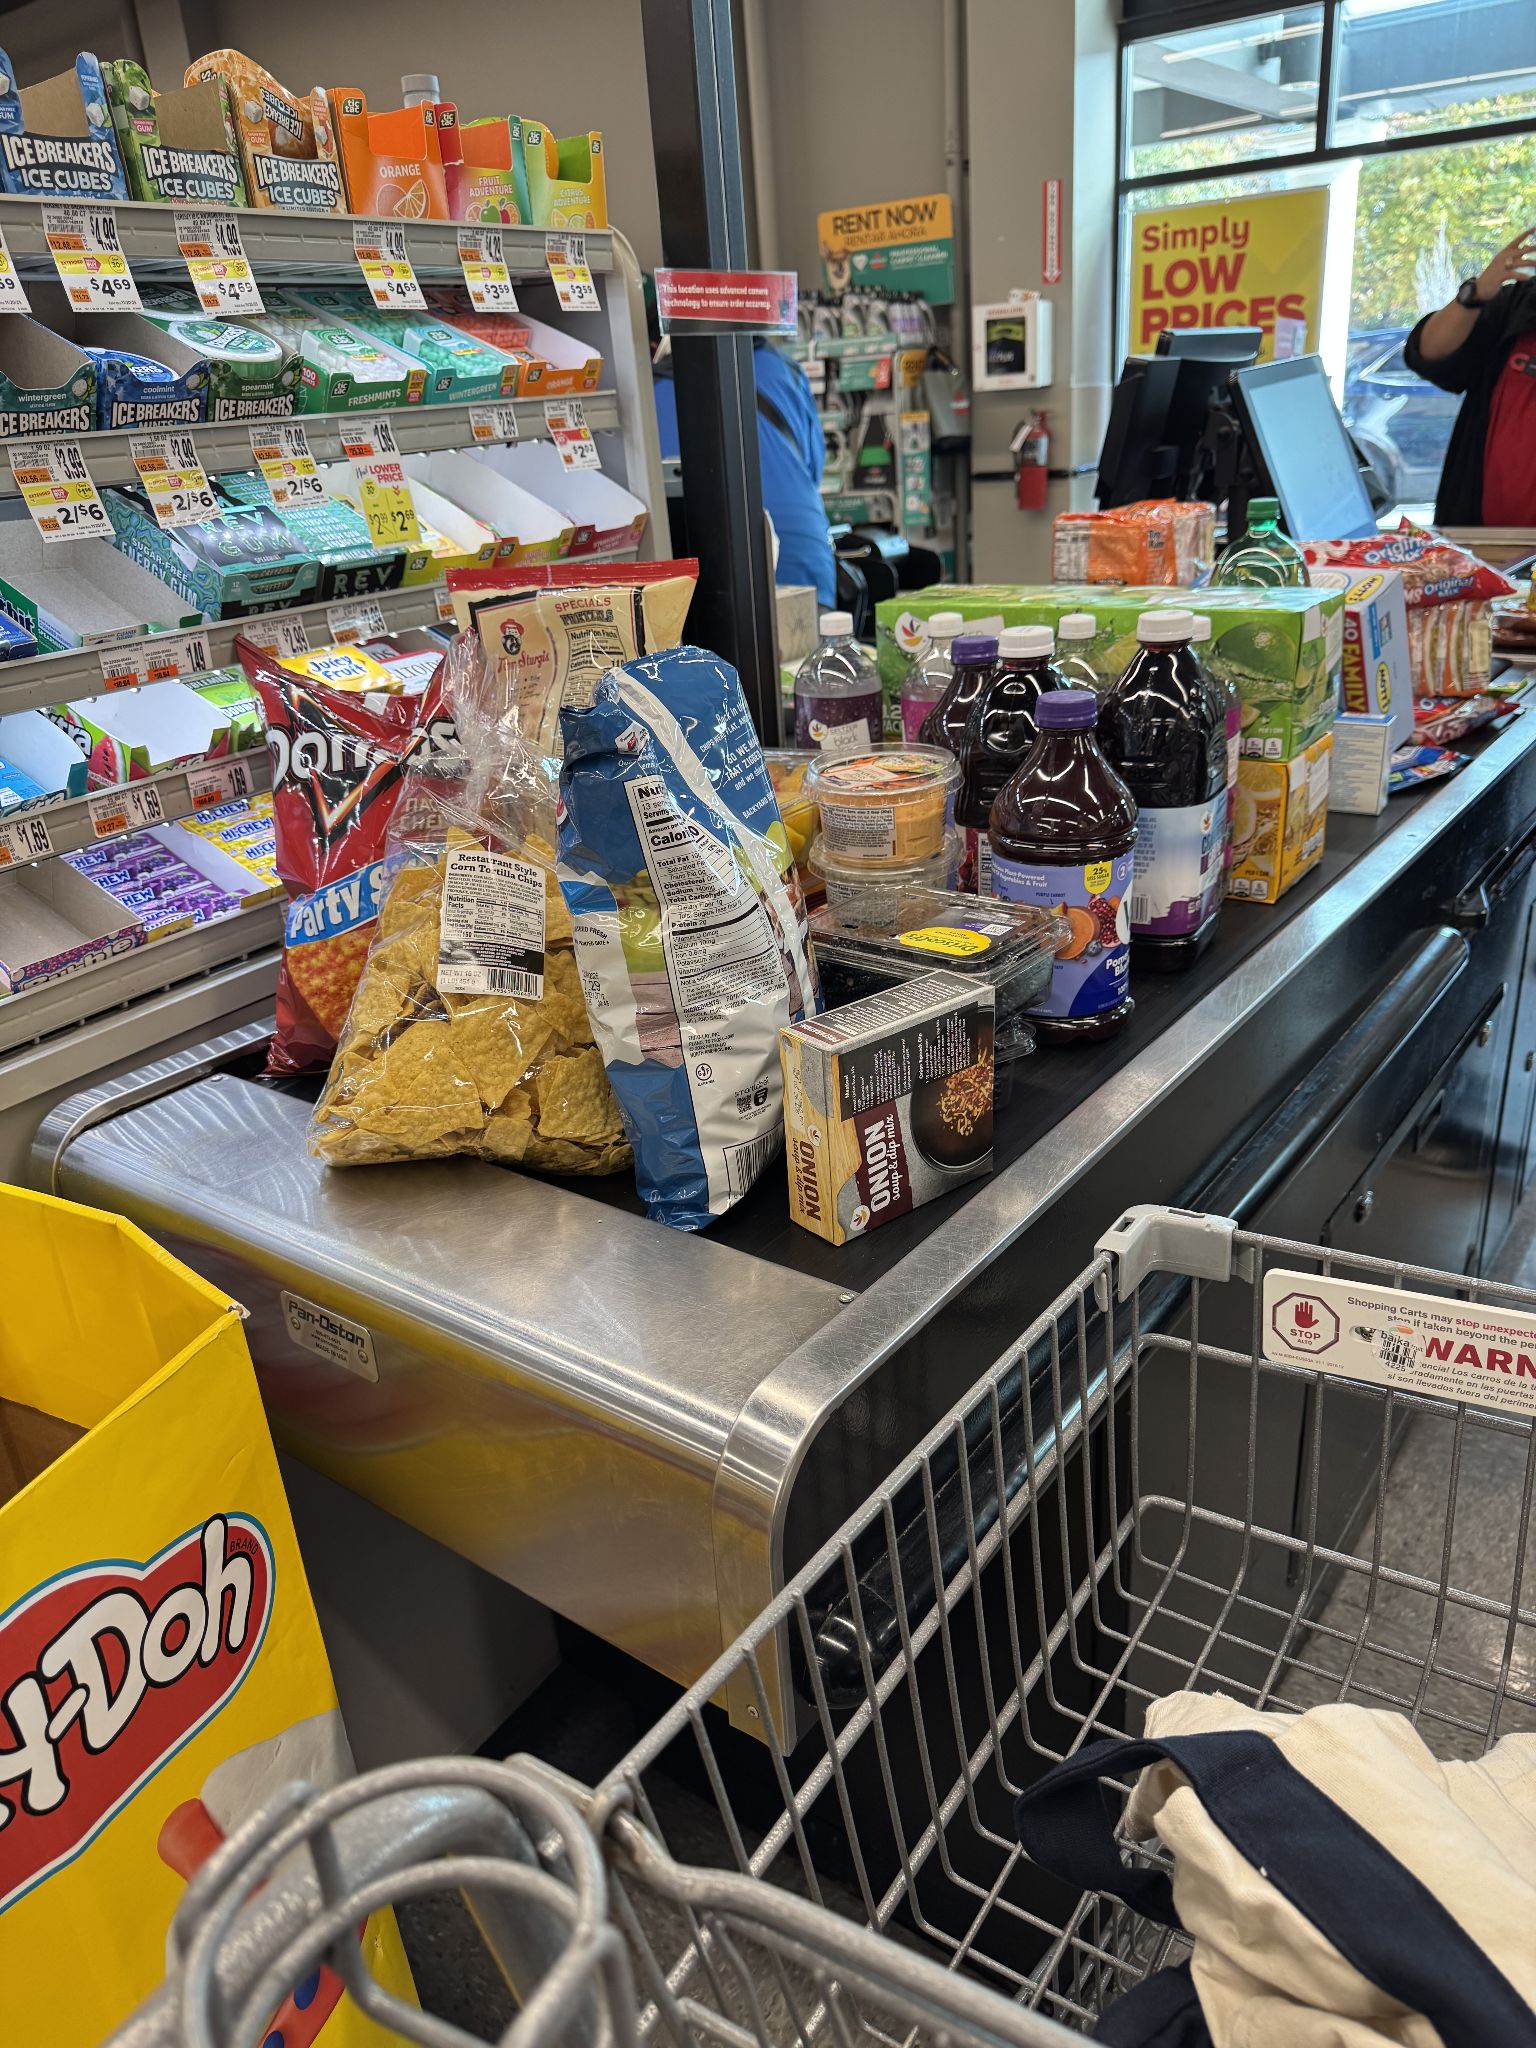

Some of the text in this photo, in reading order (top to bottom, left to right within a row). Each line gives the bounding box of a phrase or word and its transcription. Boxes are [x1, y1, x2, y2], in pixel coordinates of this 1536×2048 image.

[2, 134, 117, 174] ICE BREAKERS
[142, 145, 238, 183] ICE BREAKERS
[380, 164, 421, 179] ORANGE
[21, 169, 112, 191] ICE CUBES
[255, 157, 340, 194] ICE BREAKERS
[479, 176, 500, 187] FRUIT
[158, 179, 234, 199] ICE CUBES
[269, 185, 336, 207] ICE CUBES
[469, 185, 512, 197] ADVENTURE
[560, 189, 582, 198] CITRUS
[554, 196, 590, 206] ADVENTURE
[833, 201, 937, 236] RENT NOW
[1141, 216, 1249, 252] Simply
[1142, 253, 1247, 300] LOW
[662, 285, 768, 296] This location uses advanced camera
[664, 299, 700, 310] technology
[709, 300, 728, 309] ensure
[729, 300, 744, 309] order
[745, 300, 771, 310] accuracy.
[1140, 293, 1305, 345] PRICES
[302, 367, 316, 380] 100
[18, 392, 67, 402] wintergreen
[143, 385, 174, 394] coolmint
[241, 383, 274, 392] spearmint
[334, 387, 346, 395] tac
[449, 382, 497, 402] WINTERGREEN
[216, 394, 294, 420] ICE BREAKERS
[348, 388, 401, 407] FRESHMINTS
[19, 405, 90, 430] BREAKERS
[112, 399, 200, 427] ICE BREAKERS
[369, 463, 401, 475] LOWER
[377, 472, 404, 483] PRICE
[288, 477, 323, 496] 2/$6
[172, 491, 213, 511] 2/$6
[57, 503, 103, 524] 2/$6
[198, 512, 264, 533] REV
[219, 535, 292, 556] GUM
[132, 537, 188, 583] SUGAR-FREE
[121, 541, 197, 608] ENERGY GUM
[333, 565, 395, 593] REV
[1424, 577, 1474, 596] Original
[555, 597, 611, 613] SPECIALS
[560, 610, 613, 626] PRETZELS
[570, 629, 618, 640] Nutrition Facts
[309, 655, 353, 673] Juicy
[519, 650, 549, 668] Sturgis
[1343, 619, 1366, 712] 40 FAMILY
[322, 665, 368, 681] Fruit
[736, 743, 749, 757] WE
[734, 777, 745, 791] and
[131, 789, 161, 821] $1.69
[196, 801, 249, 823] HI-CHEW
[644, 809, 670, 819] Serving
[742, 796, 768, 819] BACKYARD
[17, 820, 49, 853] $1.69
[97, 822, 115, 833] $11.27
[221, 818, 273, 841] HI-CHEW
[458, 854, 537, 877] Restaurant Style
[657, 856, 689, 868] Total Fat
[1093, 867, 1107, 876] 25%
[451, 863, 542, 887] Corn Chips
[1005, 866, 1045, 881] Plant-Powered
[664, 878, 705, 890] Cholesterol
[666, 888, 693, 896] Sodium
[290, 880, 360, 938] Party
[448, 895, 475, 904] Nutrition
[668, 896, 687, 904] Total
[589, 926, 608, 939] FRESH
[671, 920, 698, 928] Protein
[865, 1120, 891, 1213] ONION
[885, 1113, 903, 1201] soup & dip mix
[796, 1174, 804, 1194] dip
[800, 1140, 822, 1222] ONION
[797, 1194, 805, 1214] mix
[1348, 1297, 1397, 1314] Shopping
[1400, 1306, 1428, 1319] Carts
[1430, 1314, 1453, 1325] may
[1456, 1318, 1480, 1330] stop
[288, 1300, 365, 1348] Pan-Oston
[1423, 1321, 1453, 1334] taken
[1456, 1328, 1496, 1342] beyond
[1499, 1335, 1517, 1345] the
[1290, 1328, 1321, 1340] STOP
[1385, 1361, 1406, 1372] 4225
[1452, 1367, 1528, 1389] Los carros de la
[1398, 1377, 1414, 1385] son
[1416, 1379, 1454, 1393] llevados
[1457, 1387, 1481, 1398] fuera
[1483, 1393, 1499, 1402] del
[1480, 1383, 1494, 1392] las
[1497, 1387, 1534, 1400] puertas
[229, 1538, 259, 1556] BRAND
